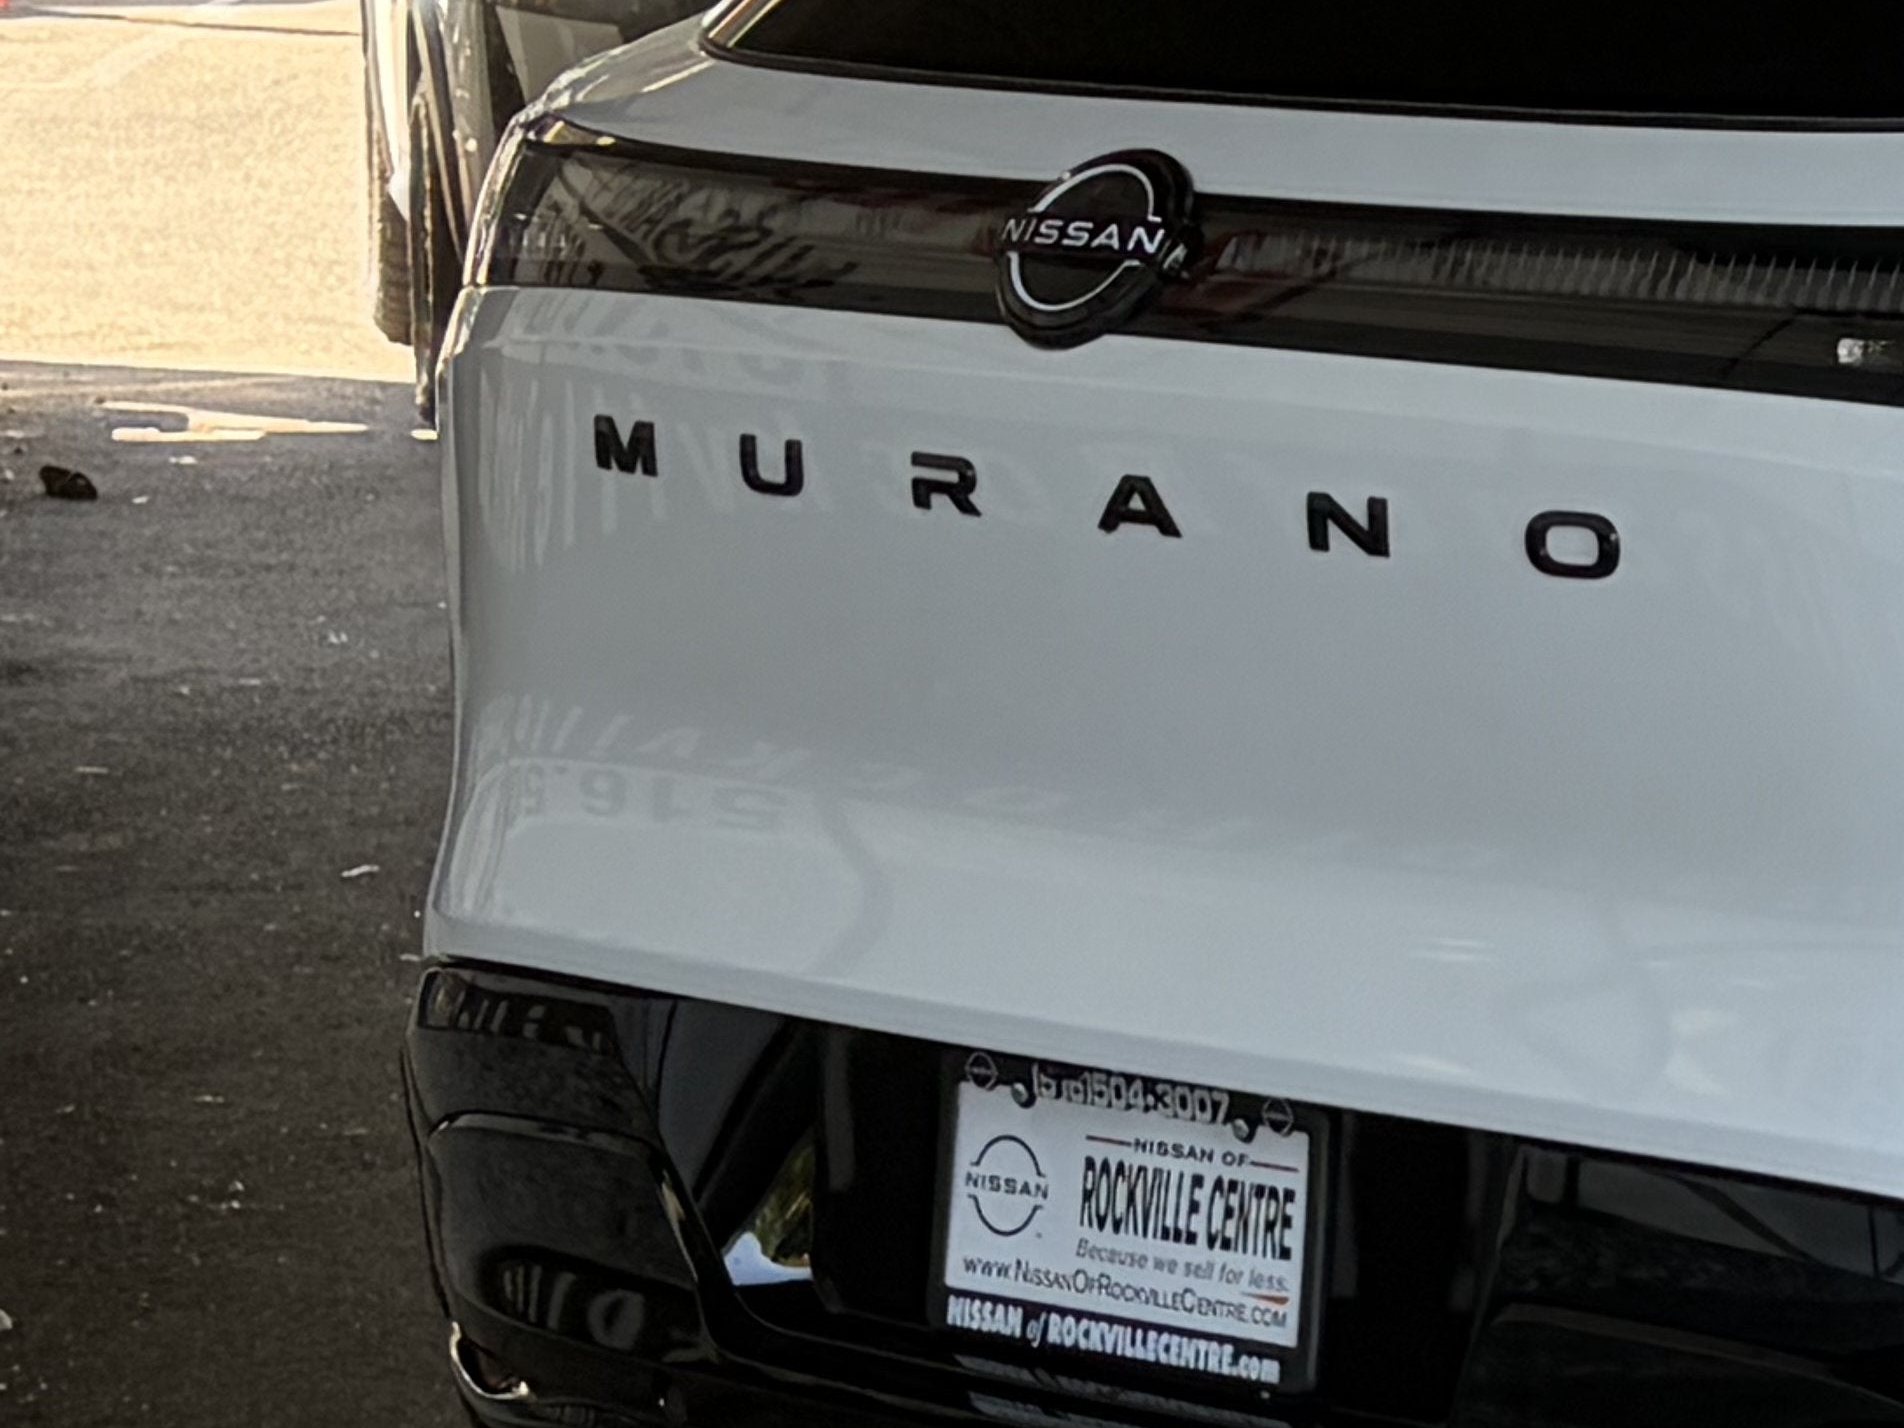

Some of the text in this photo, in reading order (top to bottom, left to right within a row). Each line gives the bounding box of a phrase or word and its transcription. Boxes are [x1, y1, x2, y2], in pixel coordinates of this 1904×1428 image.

[1002, 218, 1165, 254] NISSAN
[592, 414, 1622, 581] MURANO
[1134, 1137, 1249, 1167] NISSAN OF
[965, 1171, 1049, 1200] NISSAN
[1079, 1155, 1296, 1261] ROCKVILLE CENTRE
[1075, 1237, 1148, 1270] Because
[1153, 1256, 1178, 1272] we
[1184, 1259, 1215, 1281] sell
[1218, 1262, 1243, 1286] for
[946, 1294, 1281, 1384] NISSAN of ROCKVILLECENTRE.com
